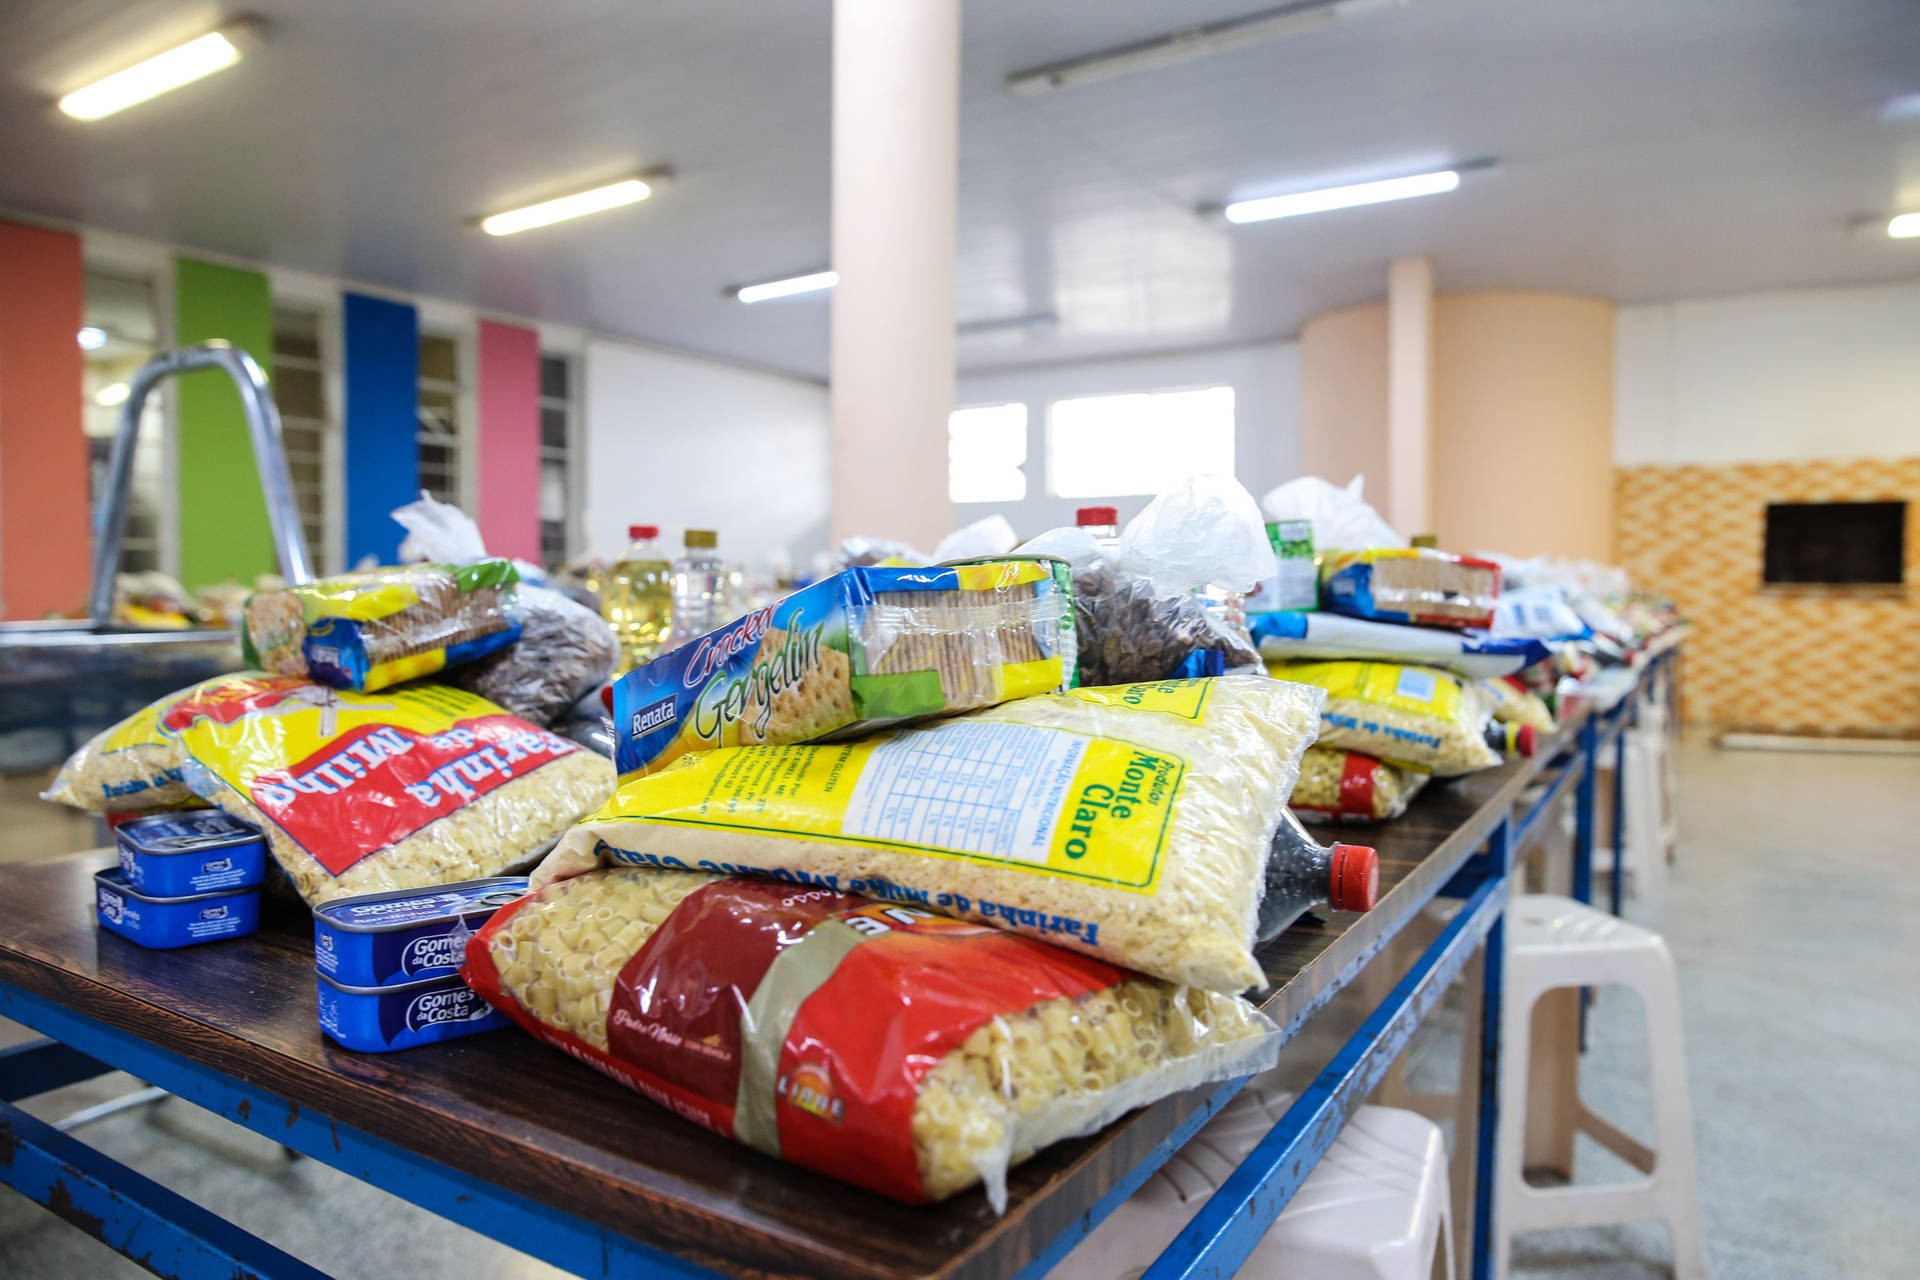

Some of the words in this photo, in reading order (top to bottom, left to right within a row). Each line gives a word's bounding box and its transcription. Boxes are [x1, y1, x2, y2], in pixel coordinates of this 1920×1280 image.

[684, 599, 784, 687] Cracker
[632, 701, 676, 735] Renata
[431, 726, 476, 750] de
[262, 726, 416, 807] Milho
[404, 728, 577, 808] Farinha
[1147, 759, 1177, 806] Produtos
[1111, 750, 1160, 819] Monte
[1032, 779, 1063, 846] NUTRICIONAL
[1065, 783, 1115, 860] Claro
[350, 897, 437, 914] Gomes
[368, 902, 436, 916] Costa
[936, 893, 971, 913] de
[979, 899, 1099, 946] Farinha
[411, 956, 423, 966] da
[422, 950, 466, 968] Costa
[413, 936, 466, 956] Gome
[416, 1010, 428, 1021] da
[426, 1003, 470, 1023] Costa
[418, 989, 475, 1012] Gomes
